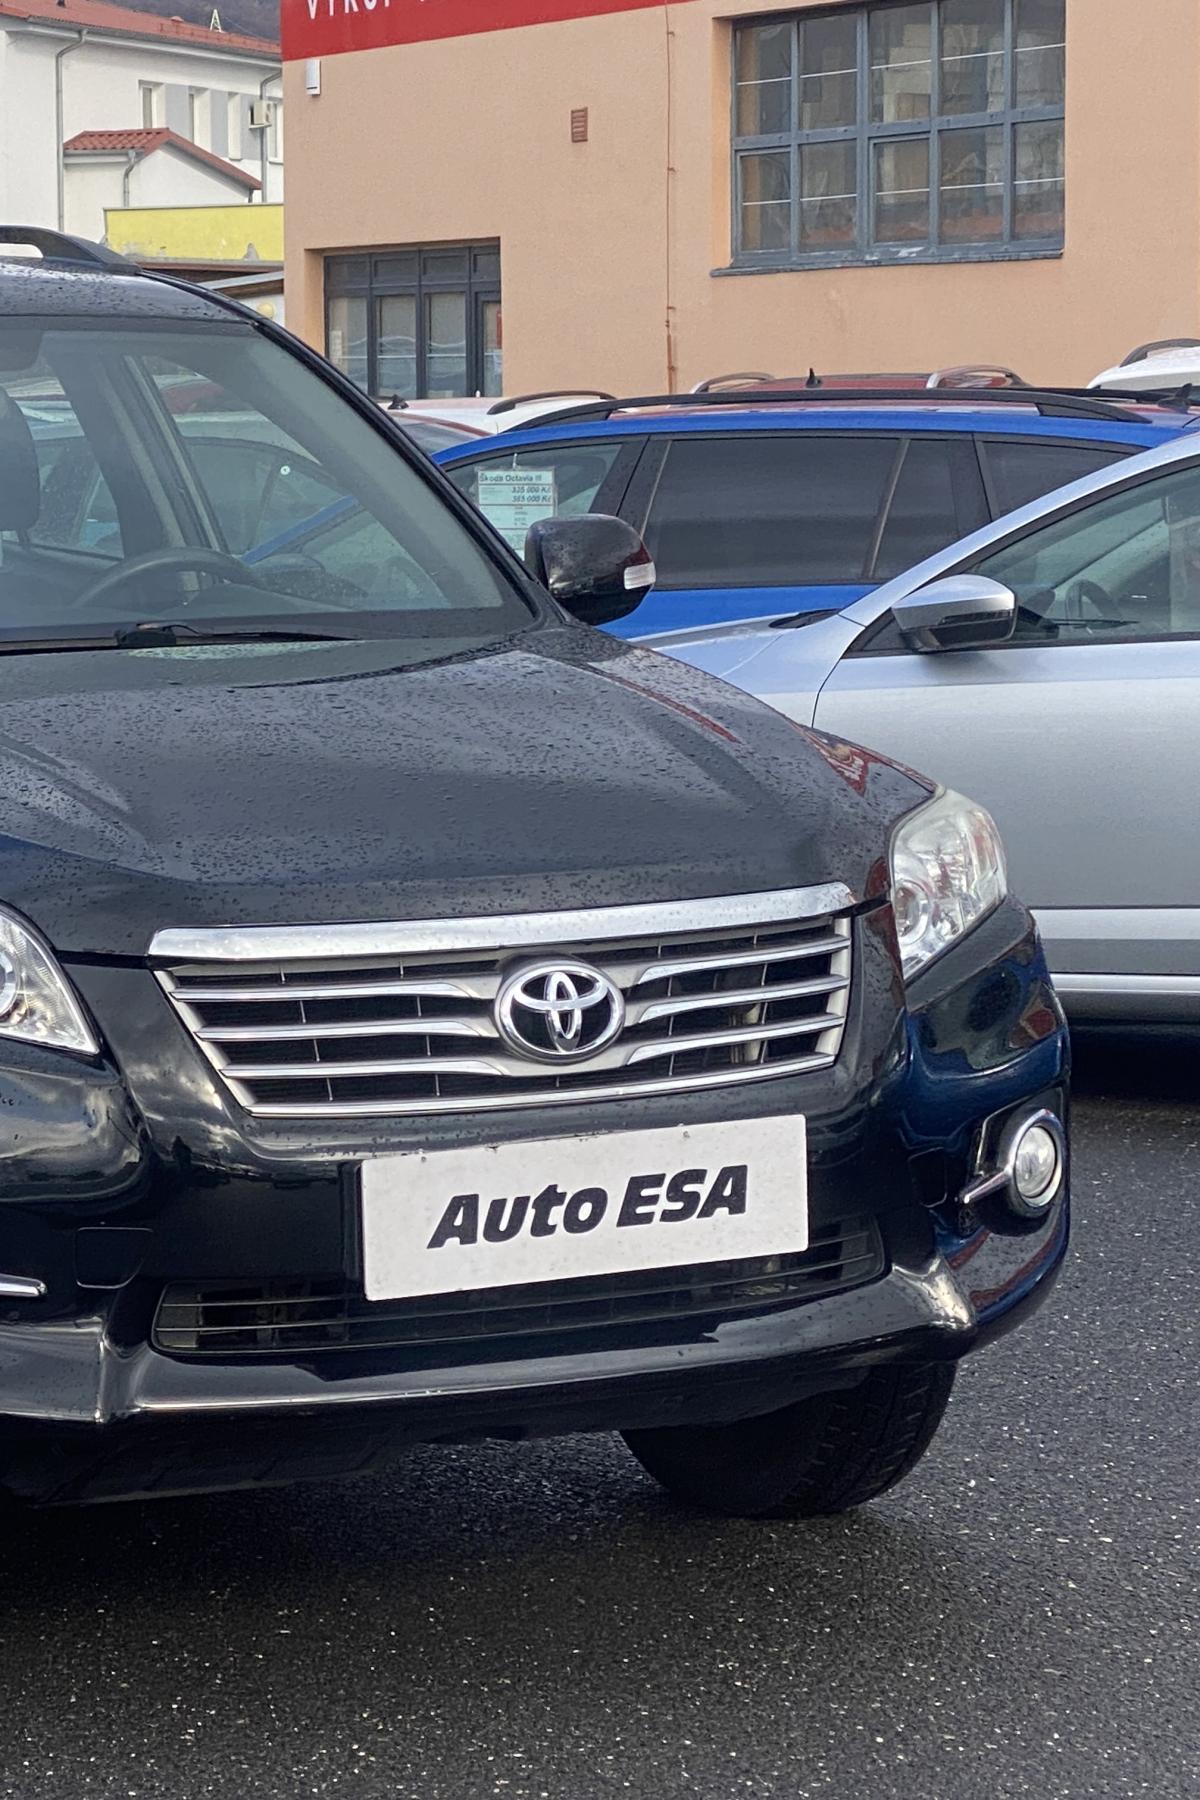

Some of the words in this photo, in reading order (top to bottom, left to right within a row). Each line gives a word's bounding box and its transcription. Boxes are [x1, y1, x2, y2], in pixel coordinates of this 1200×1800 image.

[480, 473, 504, 482] Škoda
[505, 474, 534, 482] Octavia
[426, 1184, 608, 1249] Auto
[616, 1164, 748, 1228] ESA
